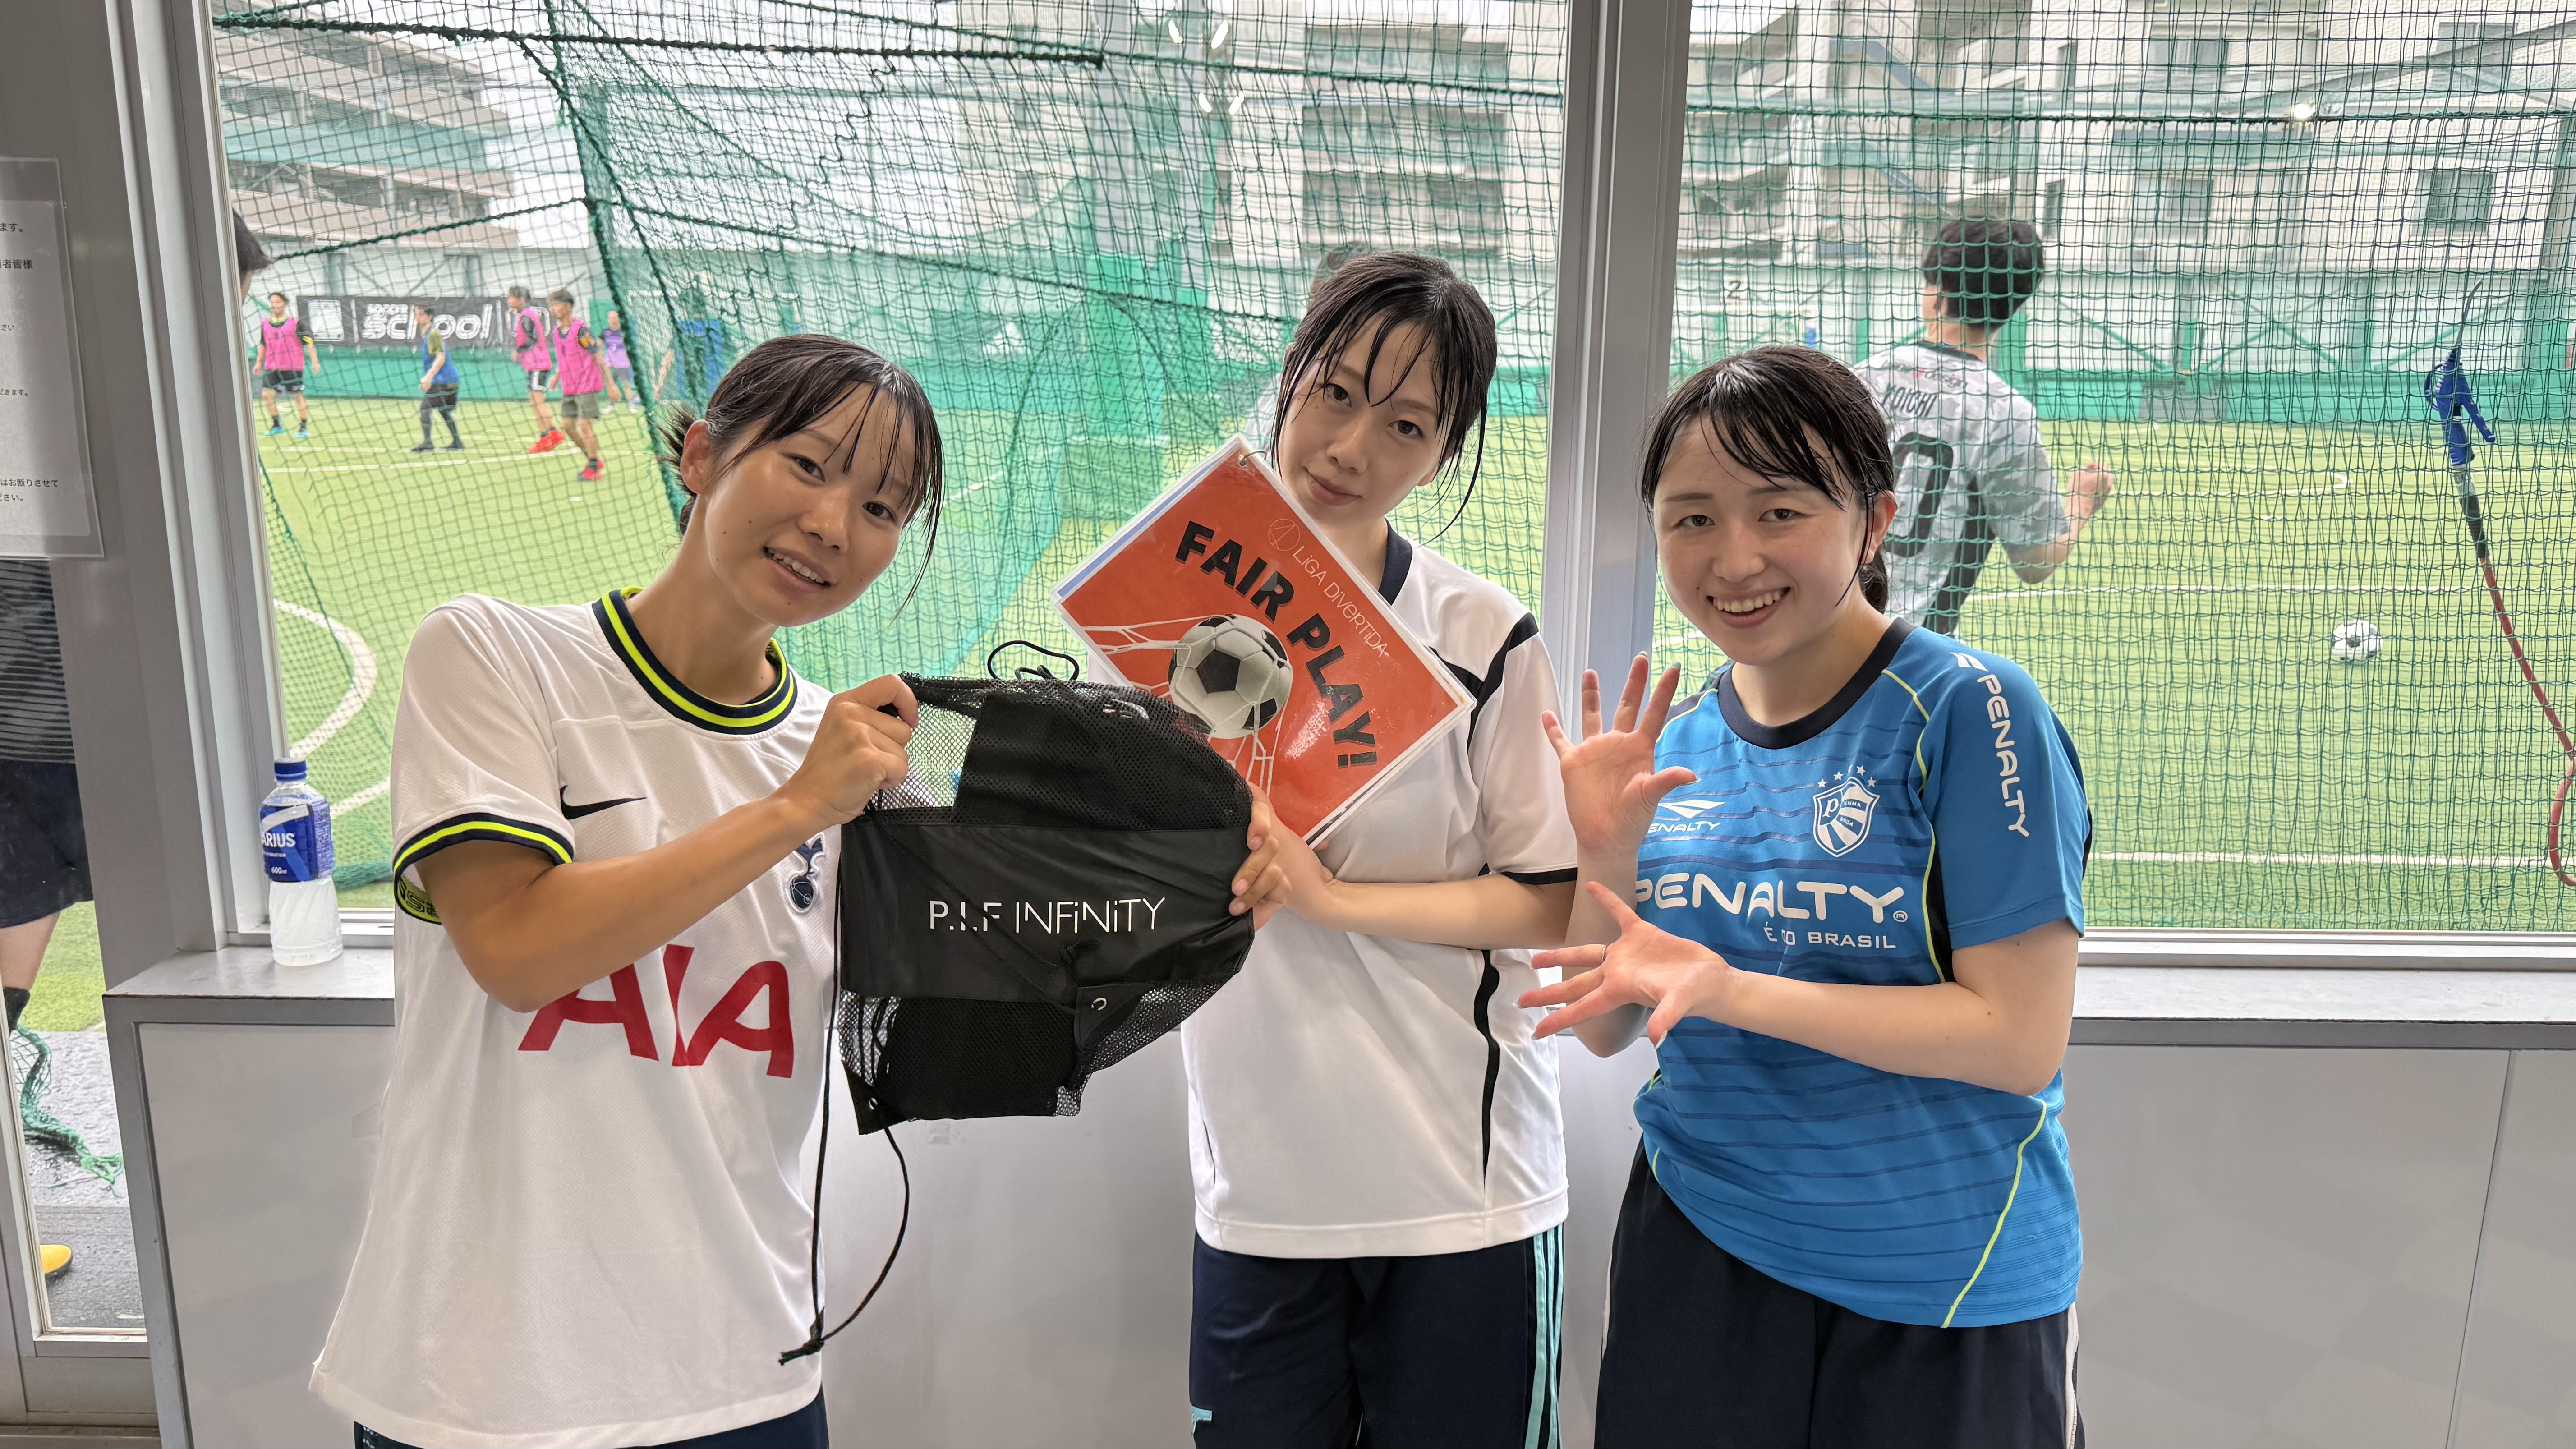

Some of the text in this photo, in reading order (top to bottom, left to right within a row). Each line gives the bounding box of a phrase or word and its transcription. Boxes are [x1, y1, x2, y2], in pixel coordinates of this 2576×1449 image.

[0, 259, 33, 269] 者皆様
[0, 478, 58, 487] はお断りさせて
[0, 493, 23, 502] さい。
[1174, 520, 1378, 769] FAIR PLAY!
[1977, 674, 2030, 837] PENALTY
[1647, 821, 1721, 833] ENALTY
[1808, 932, 1896, 949] BRASIL
[517, 943, 794, 1079] AIA
